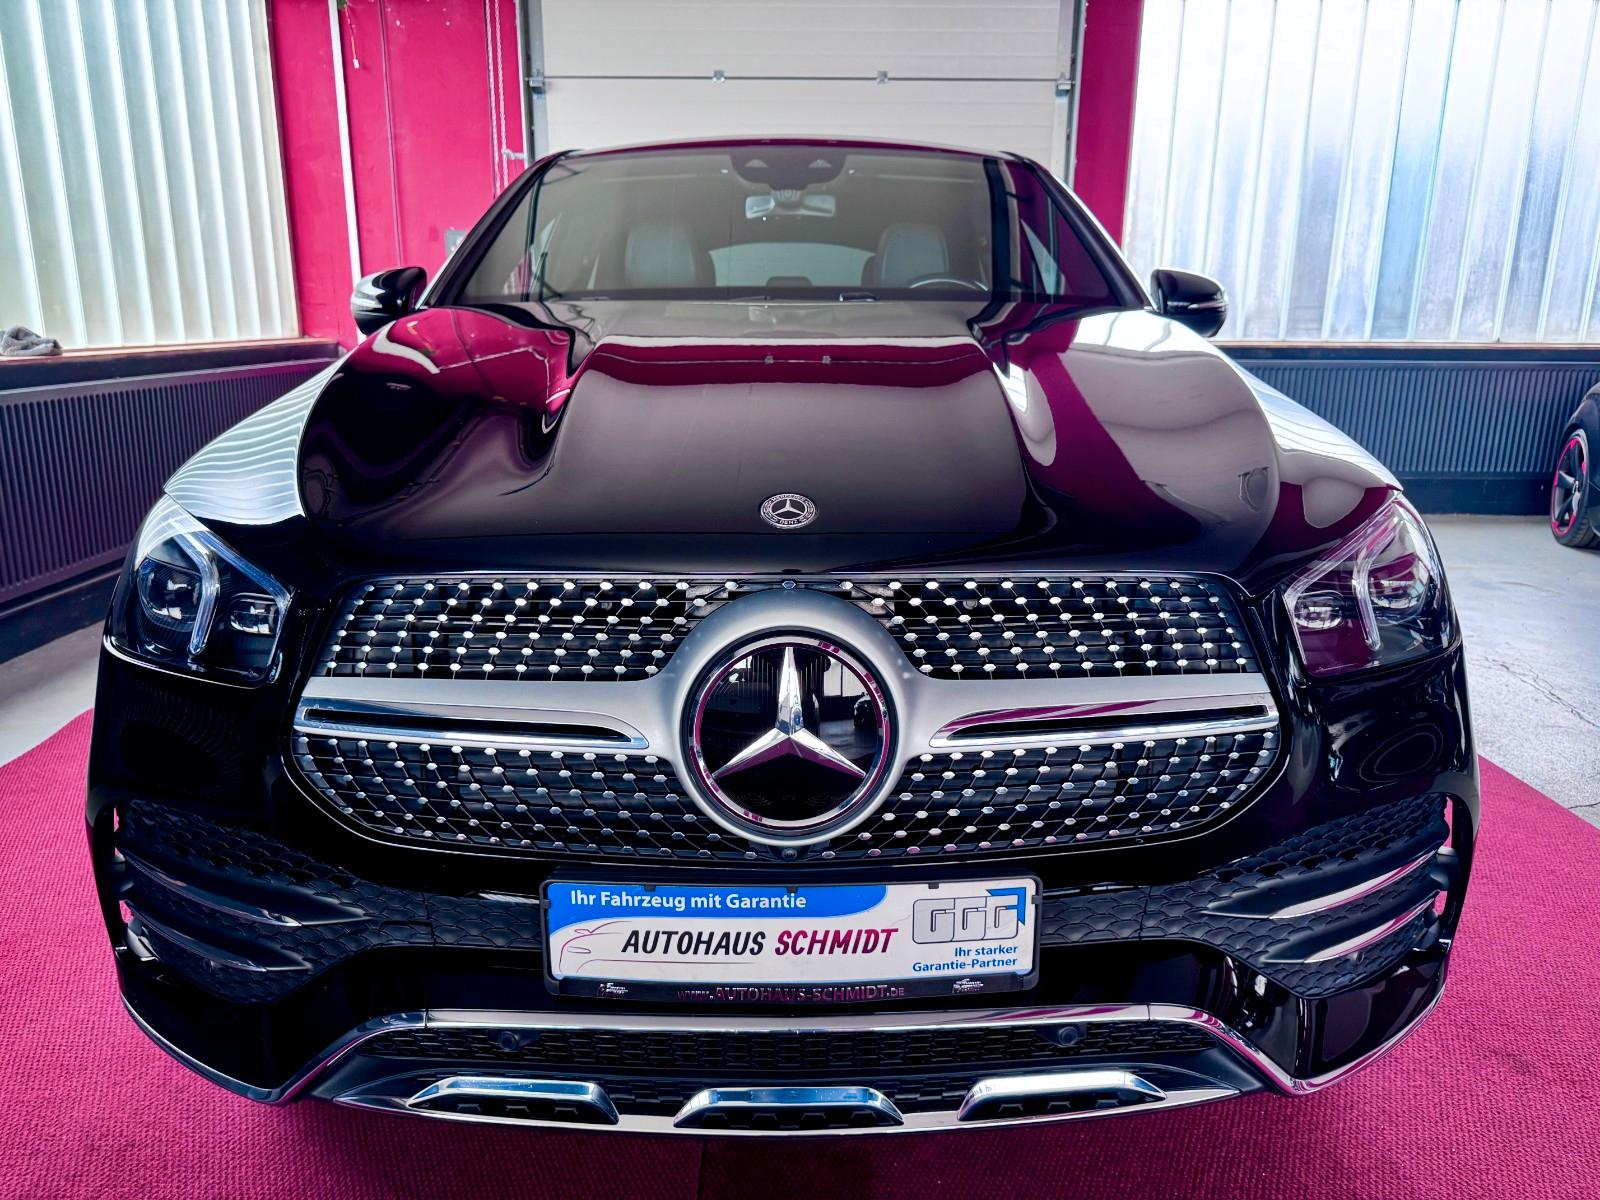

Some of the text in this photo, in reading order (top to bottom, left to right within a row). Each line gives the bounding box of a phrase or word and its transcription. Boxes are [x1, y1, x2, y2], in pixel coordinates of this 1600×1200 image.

[571, 890, 807, 912] Ihr Fahrzeug mit Garantie
[621, 927, 899, 956] AUTOHAUS SCHMIDT
[954, 944, 1019, 957] Ihr starker
[912, 957, 1019, 972] Garantie-Partner
